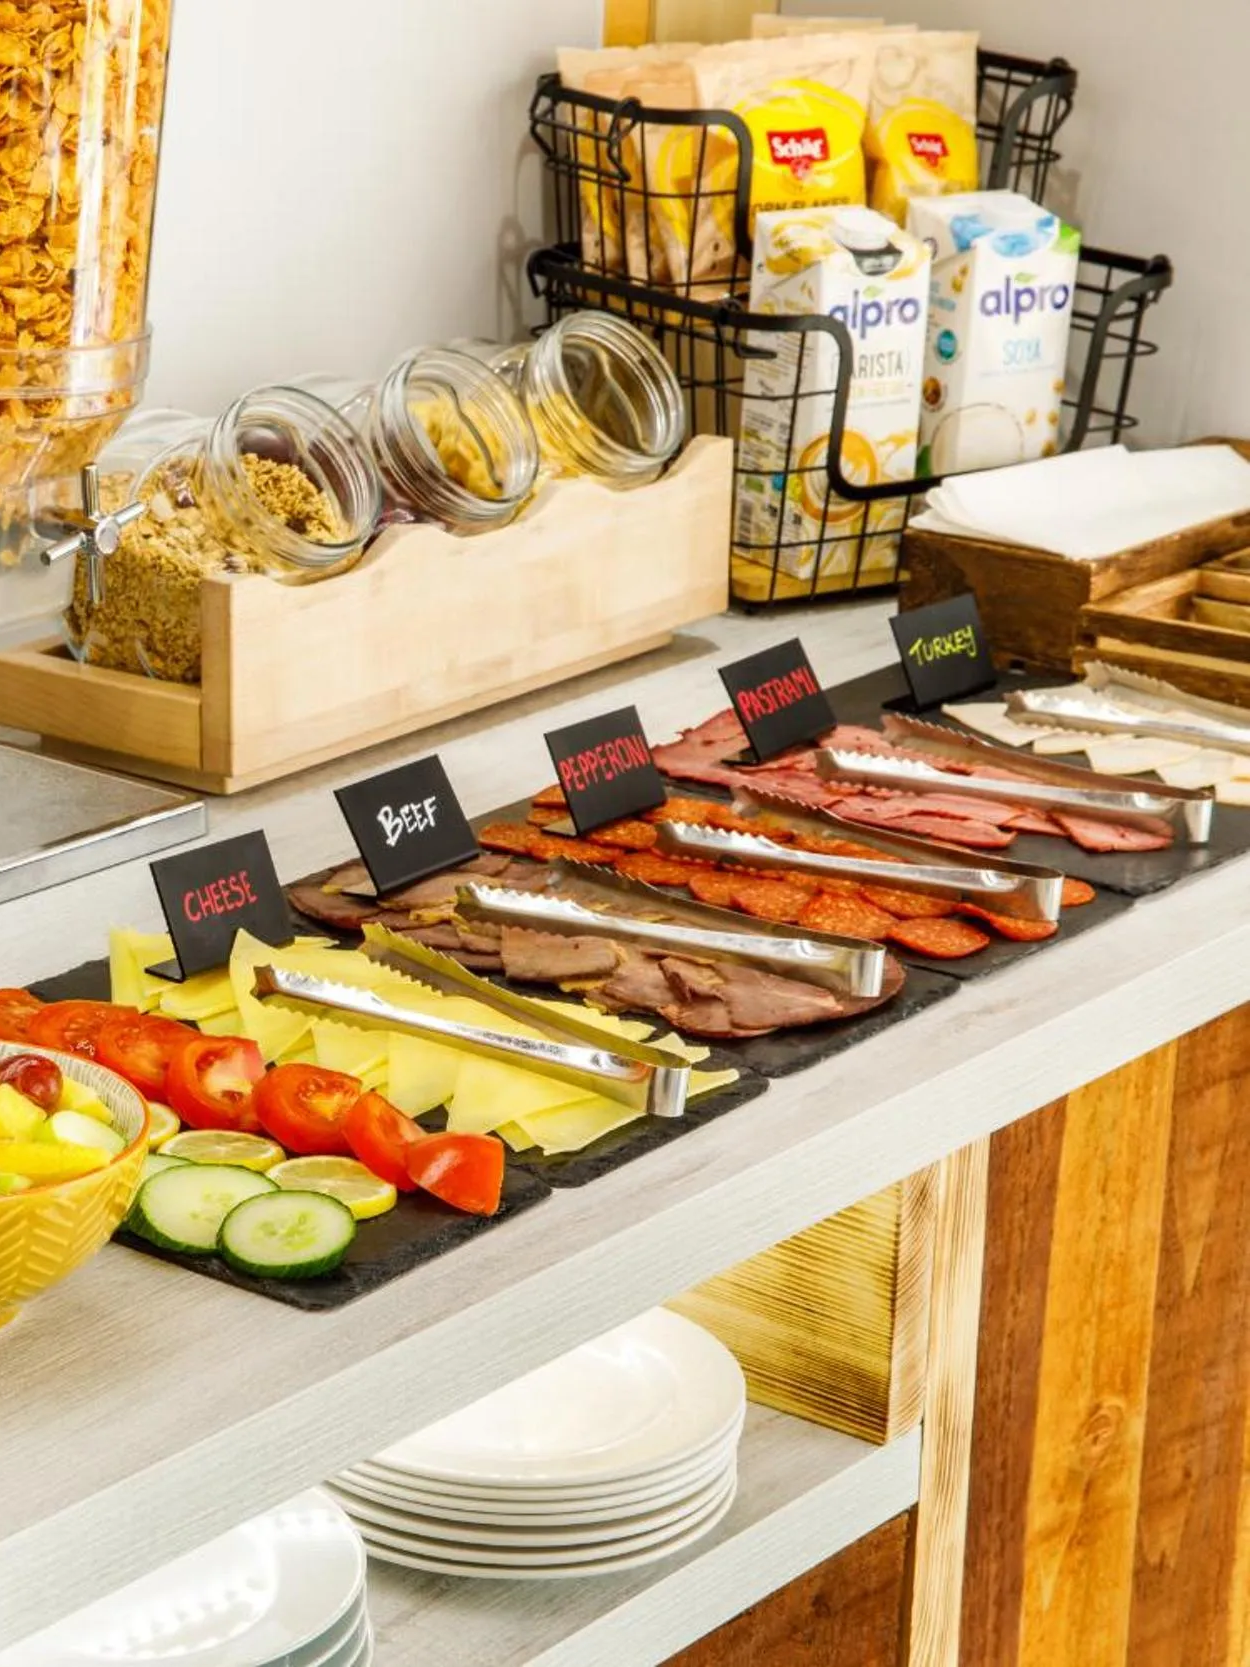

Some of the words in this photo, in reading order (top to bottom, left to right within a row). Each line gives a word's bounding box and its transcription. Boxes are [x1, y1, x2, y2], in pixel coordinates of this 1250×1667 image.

[828, 289, 920, 340] alpro
[980, 275, 1070, 325] alpro
[908, 624, 977, 667] TURKEY
[736, 666, 818, 724] PASTRAMI
[558, 733, 651, 793] PEPPERONI
[376, 795, 438, 848] BEEF
[183, 870, 258, 923] CHEESE
